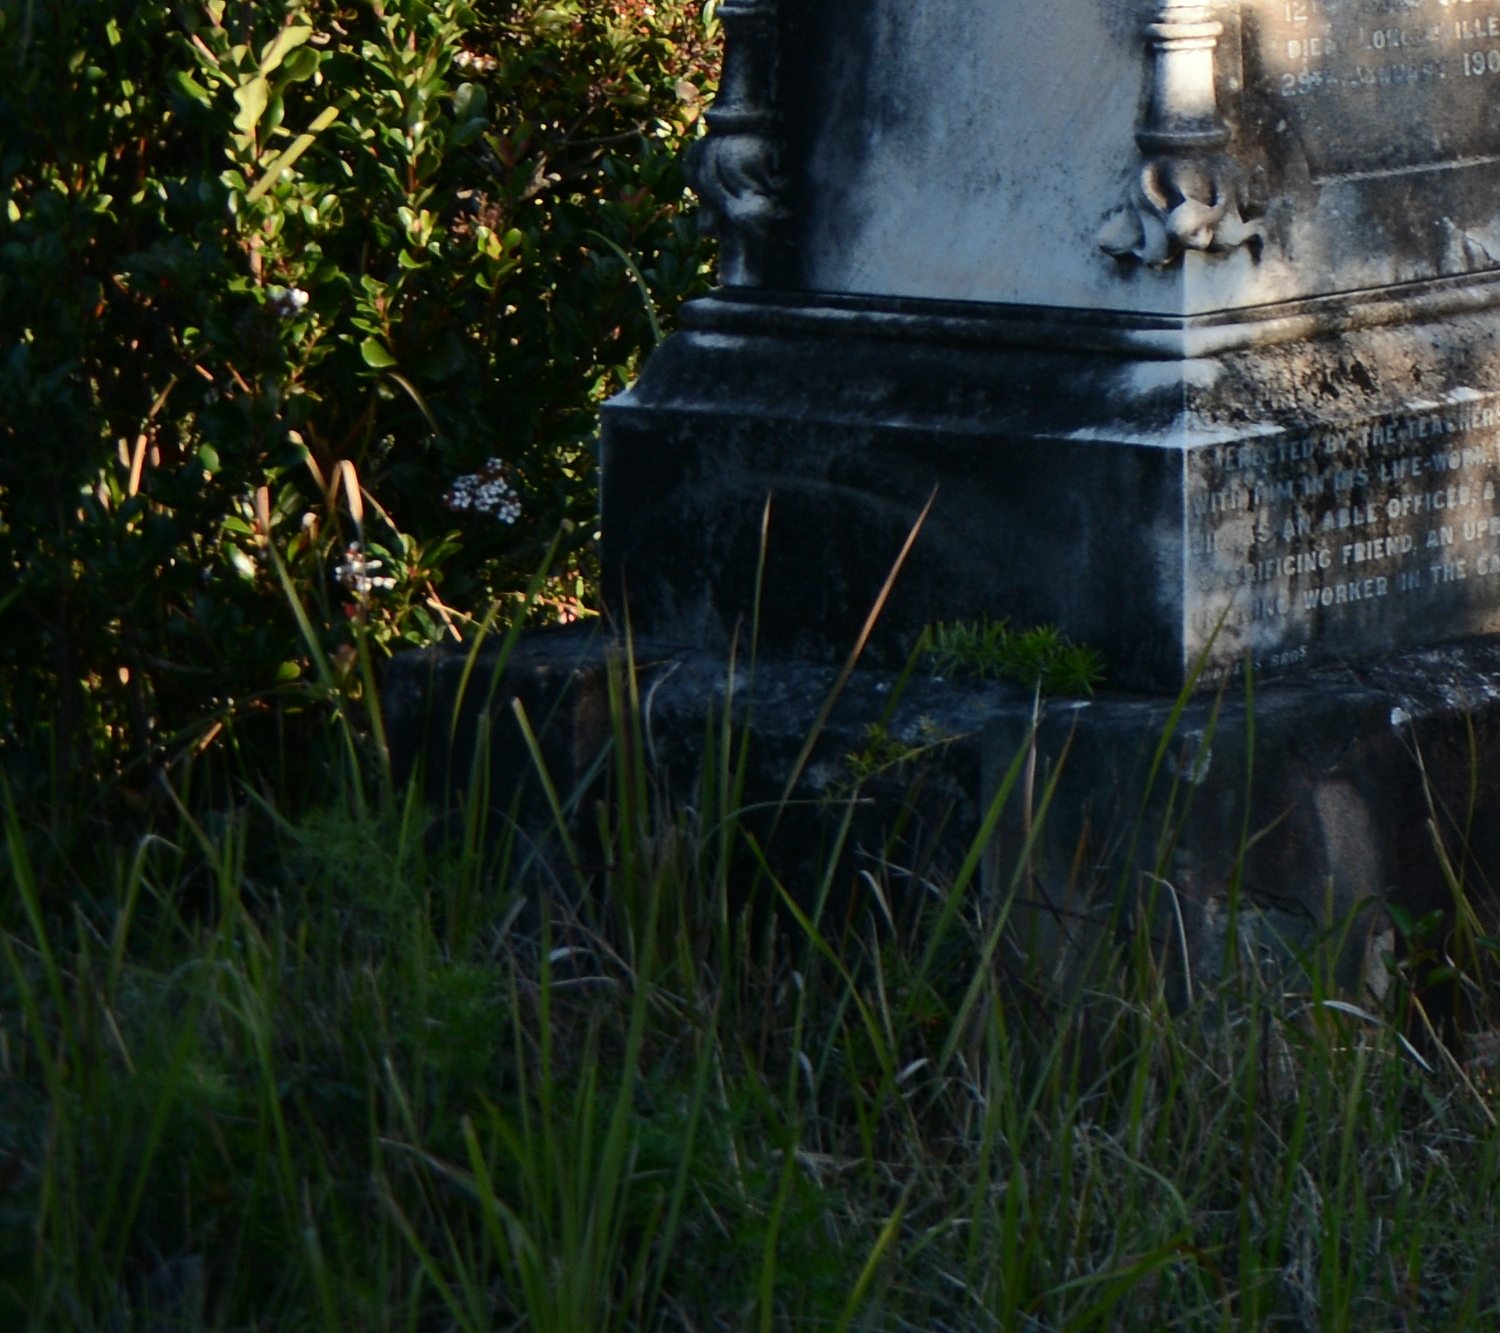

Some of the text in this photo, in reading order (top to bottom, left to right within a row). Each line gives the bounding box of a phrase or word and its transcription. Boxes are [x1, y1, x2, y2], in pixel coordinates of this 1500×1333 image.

[1326, 432, 1349, 454] BY
[1323, 502, 1379, 531] ABLE
[1483, 480, 1495, 501] A
[1427, 525, 1454, 548] AN
[1303, 575, 1388, 610] WORKER
[1401, 569, 1420, 591] IN
[1431, 559, 1467, 585] THE
